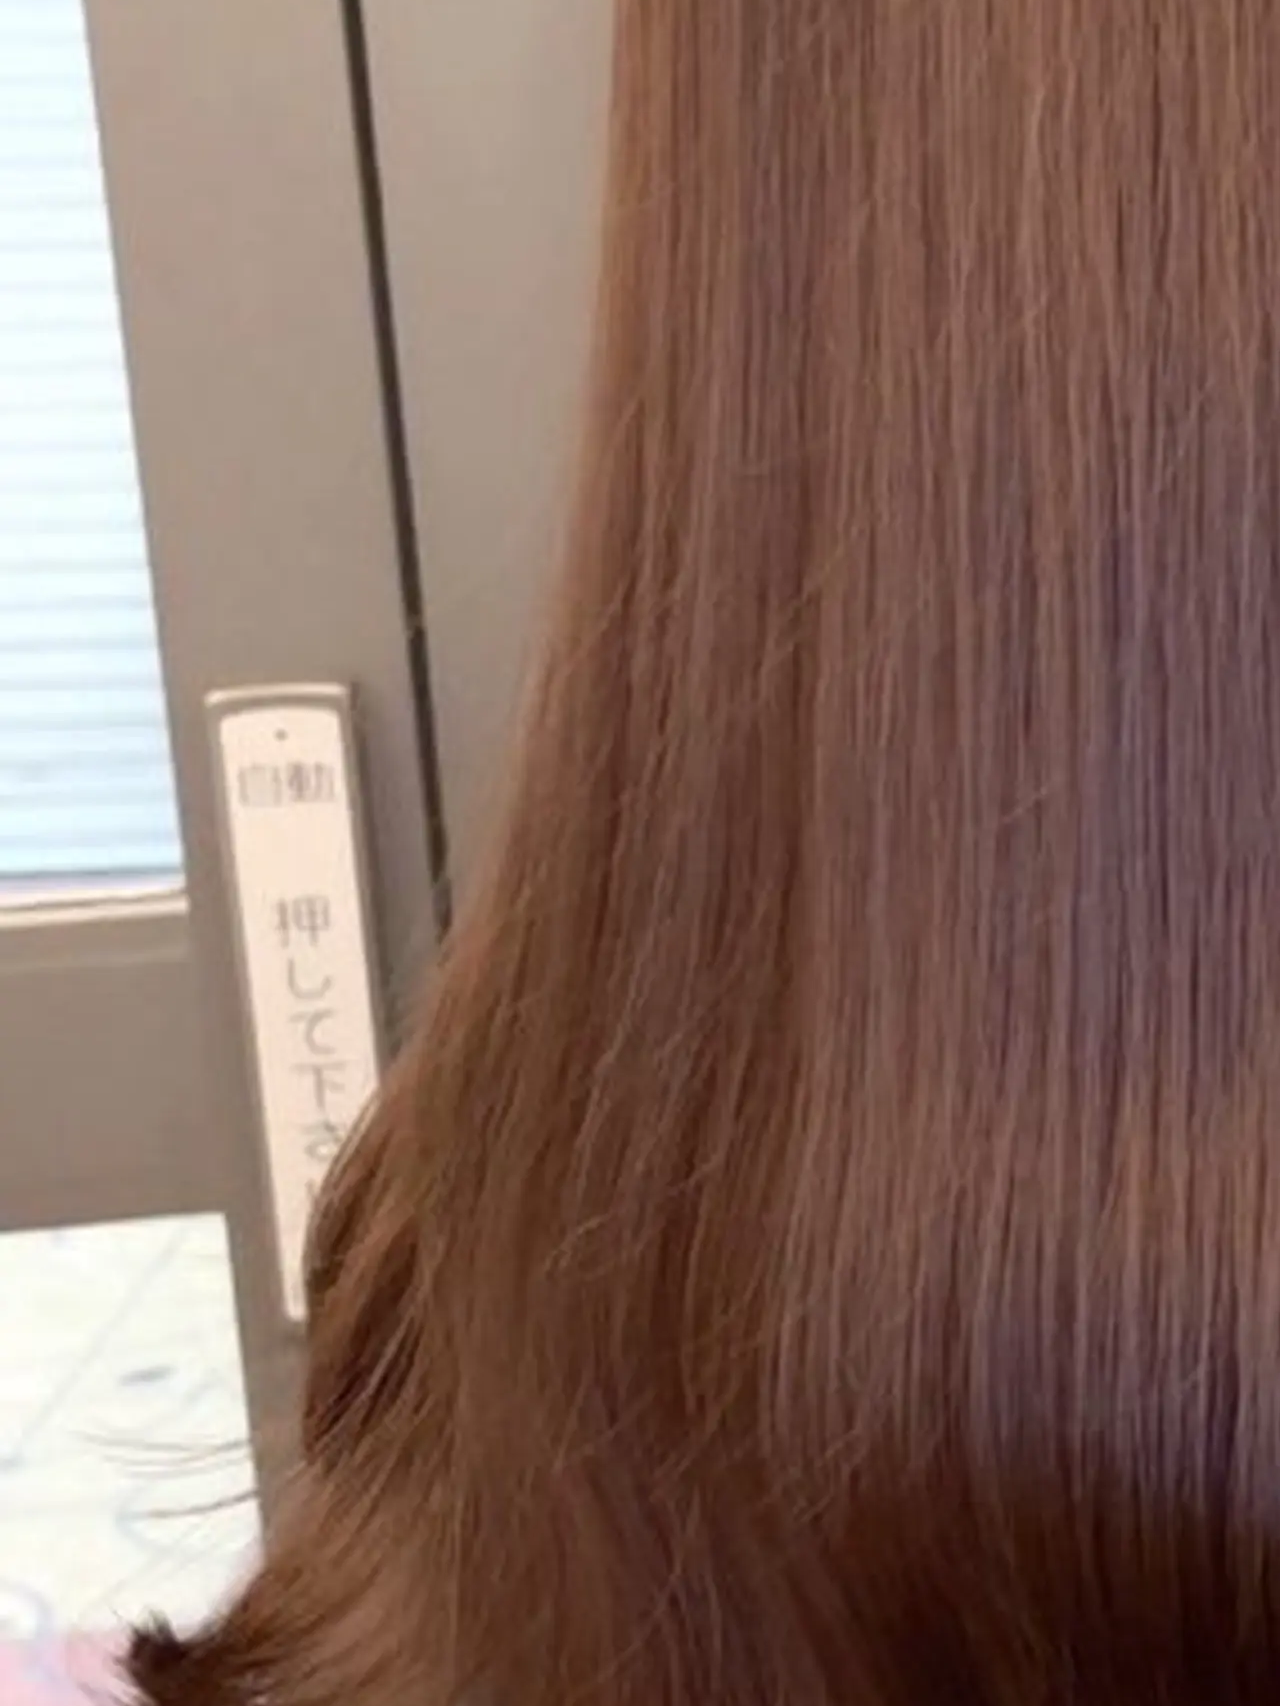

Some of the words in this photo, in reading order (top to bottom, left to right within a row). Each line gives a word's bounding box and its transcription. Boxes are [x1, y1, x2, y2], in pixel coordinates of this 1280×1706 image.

[237, 761, 337, 808] 自動
[273, 893, 348, 1201] 押して下さ
